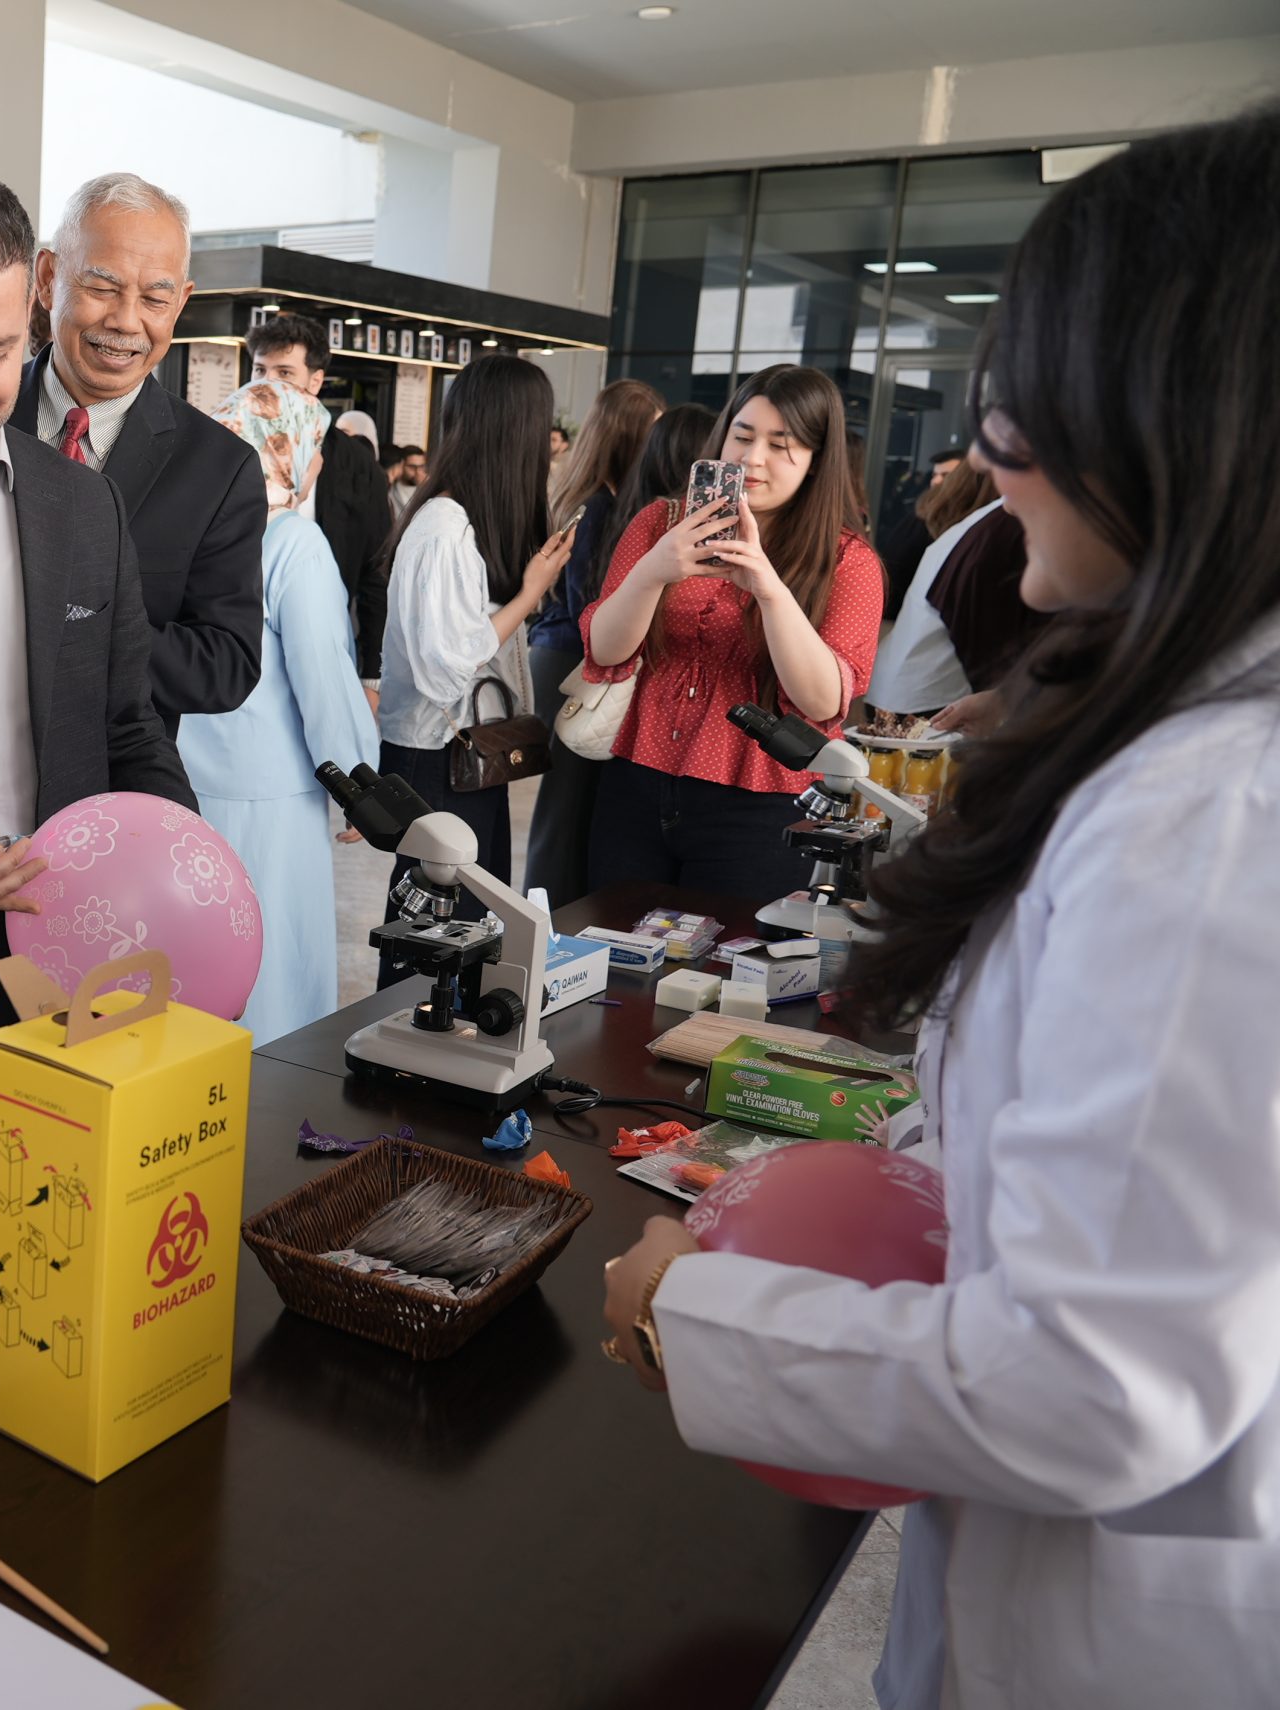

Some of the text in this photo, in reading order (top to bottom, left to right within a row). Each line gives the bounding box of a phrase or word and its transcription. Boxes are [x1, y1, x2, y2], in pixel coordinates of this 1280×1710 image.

[561, 970, 588, 988] QAIWAN
[779, 969, 801, 993] Alcohol
[793, 973, 807, 988] Pads
[208, 1083, 227, 1106] 5L
[742, 1089, 804, 1110] CLEAR POWDER FREE
[726, 1093, 744, 1105] VINYL
[746, 1098, 791, 1115] EXAMINATION
[792, 1108, 820, 1122] GLOVES
[140, 1116, 227, 1168] Safety Box
[133, 1273, 216, 1330] BIOHAZARD
